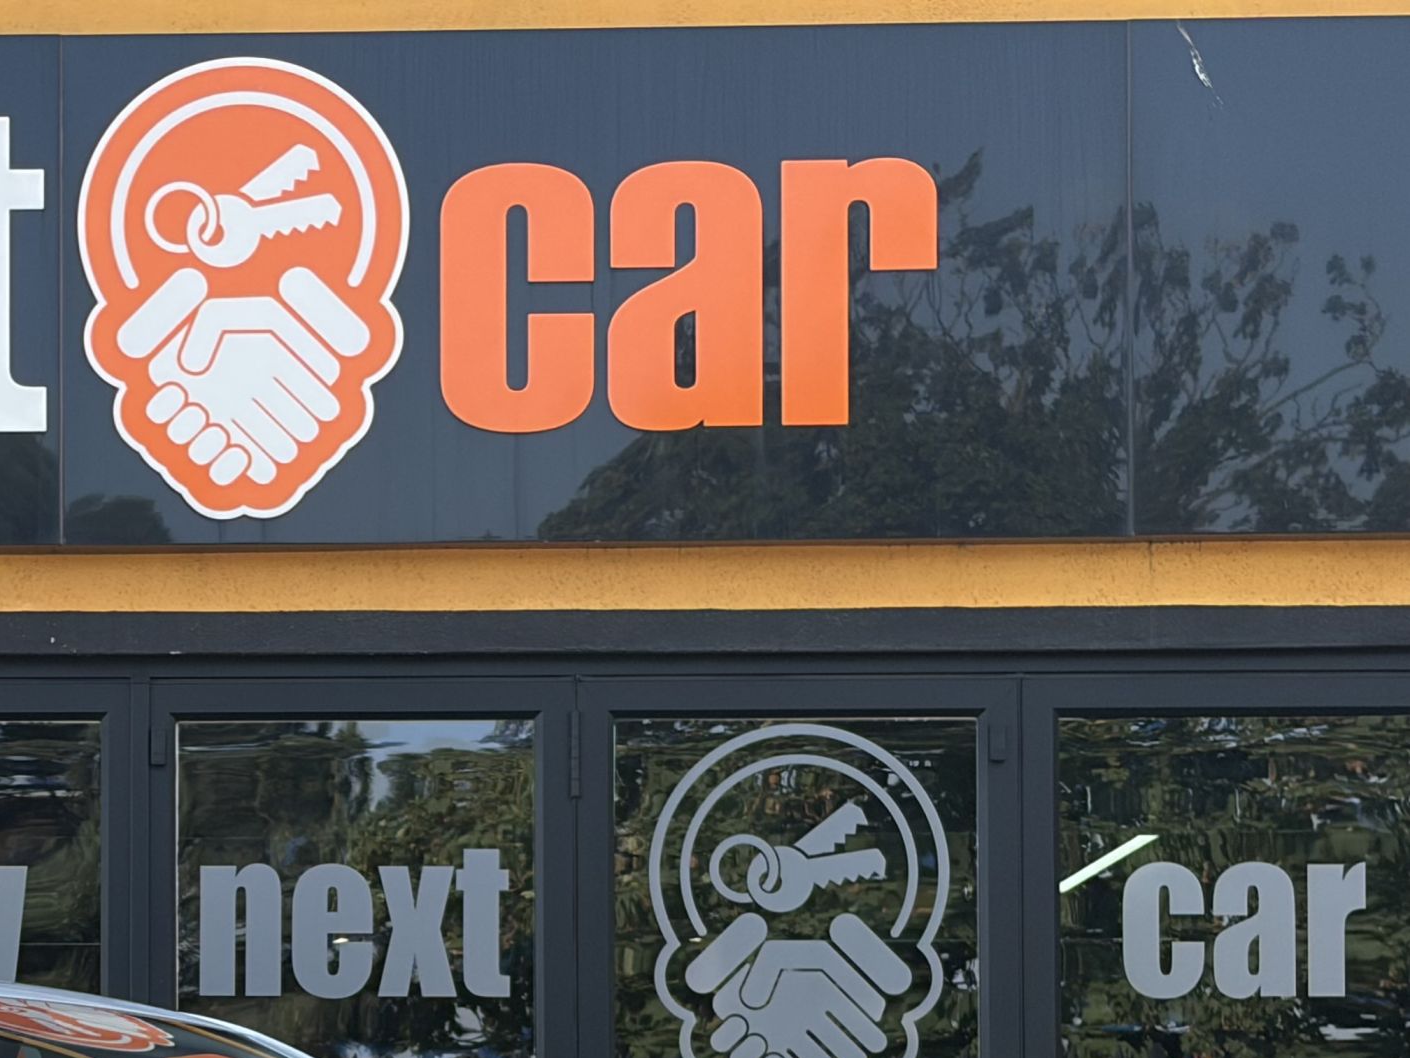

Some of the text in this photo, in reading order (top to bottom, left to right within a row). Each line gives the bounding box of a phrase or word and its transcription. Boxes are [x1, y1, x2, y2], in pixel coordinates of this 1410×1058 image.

[439, 157, 939, 434] car
[199, 848, 511, 999] next
[1122, 861, 1367, 999] car
